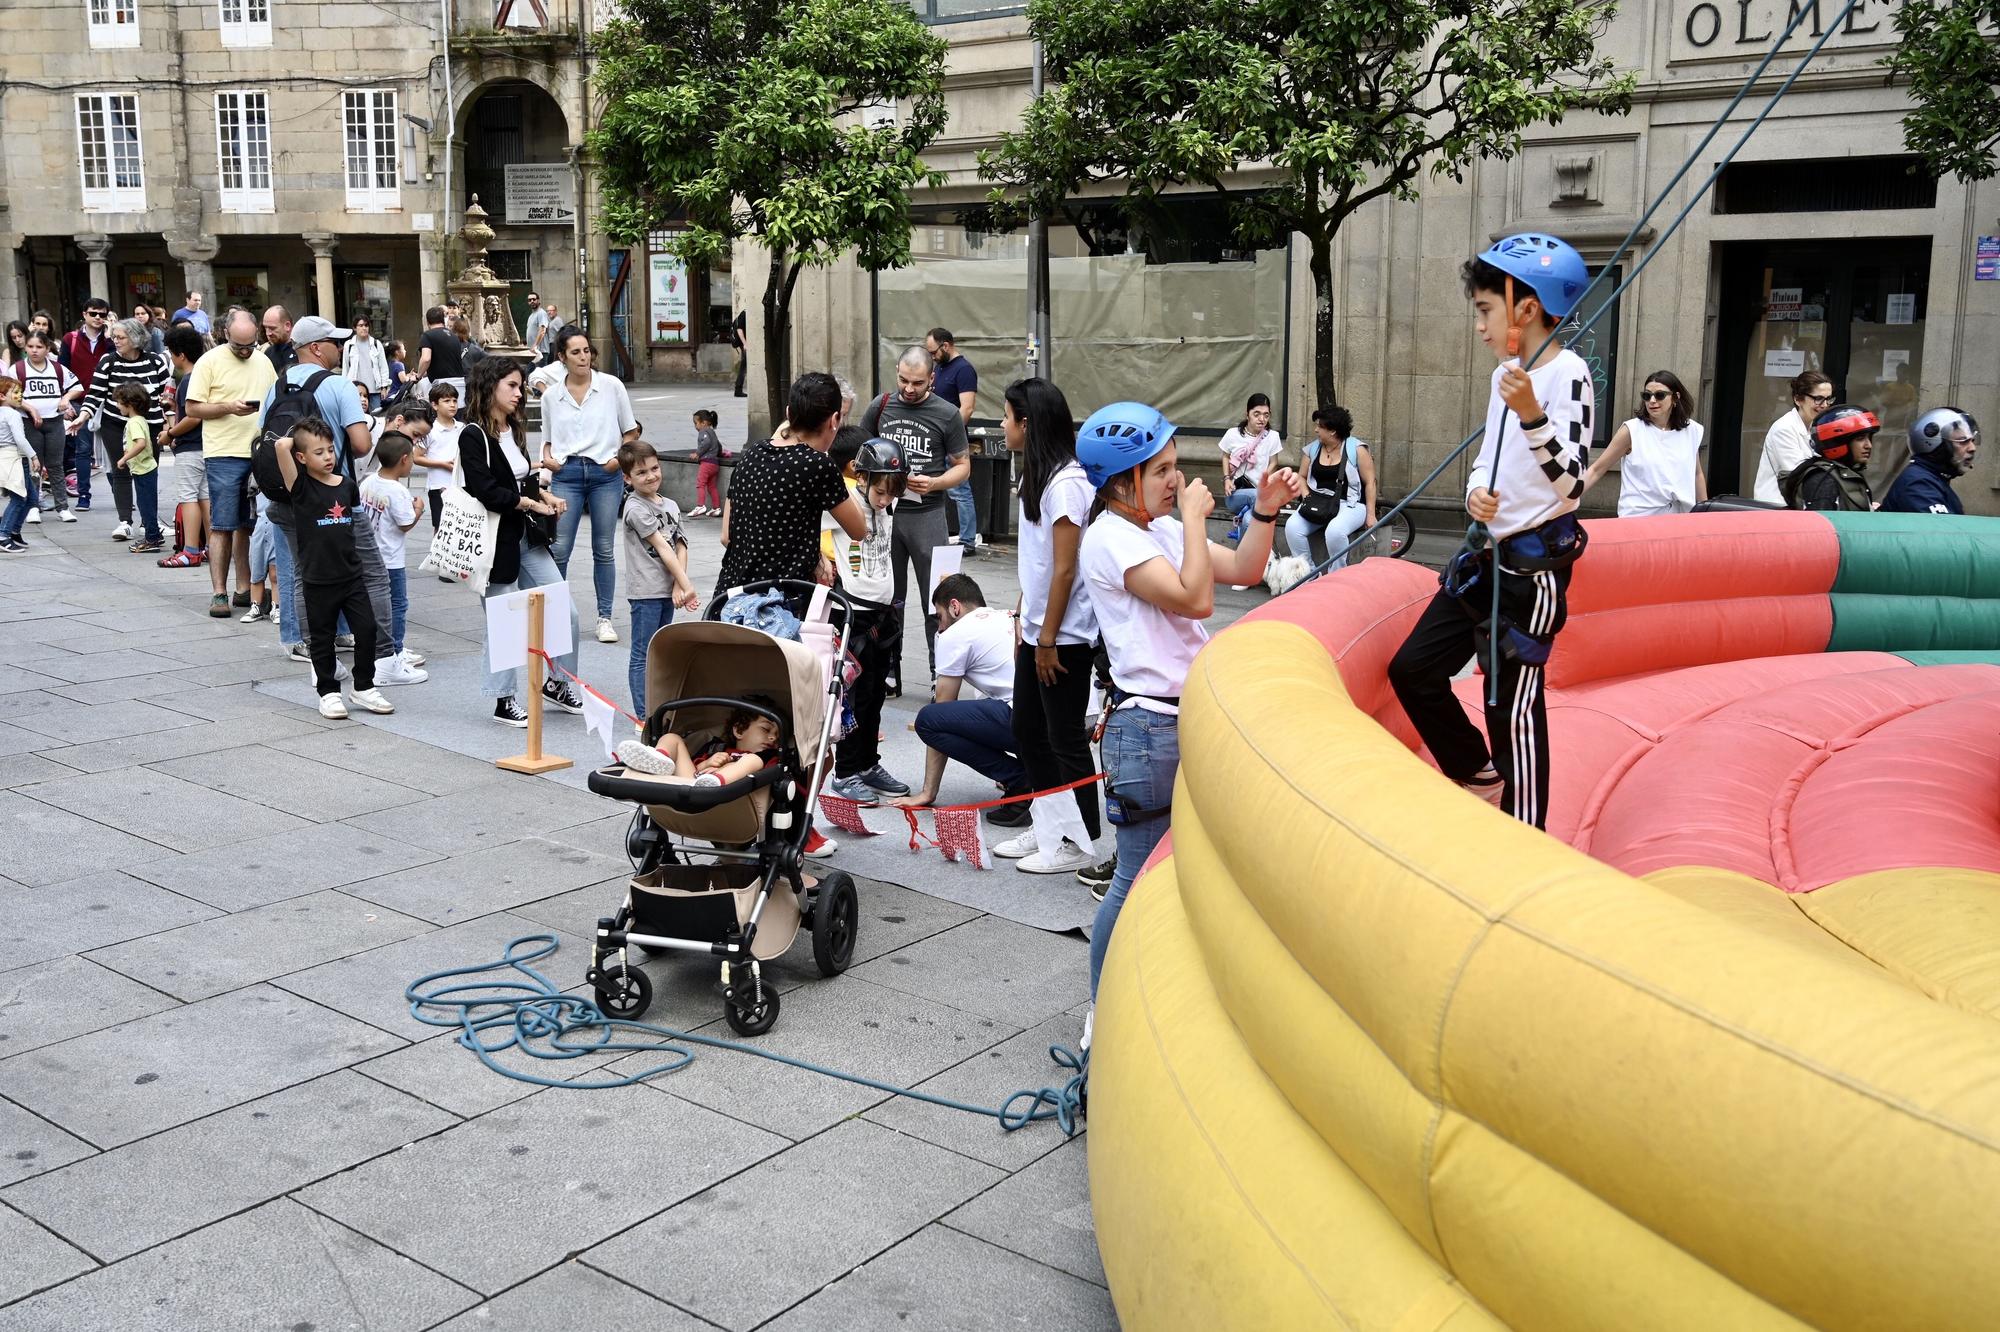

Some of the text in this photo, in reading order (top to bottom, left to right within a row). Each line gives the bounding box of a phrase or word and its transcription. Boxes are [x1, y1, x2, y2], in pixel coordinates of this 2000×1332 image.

[136, 283, 157, 294] 50%
[29, 380, 56, 394] GOOD
[462, 511, 485, 521] always
[466, 521, 482, 529] just
[455, 527, 481, 541] more
[437, 529, 483, 556] OTE BAG
[441, 544, 449, 553] the
[450, 569, 459, 578] my
